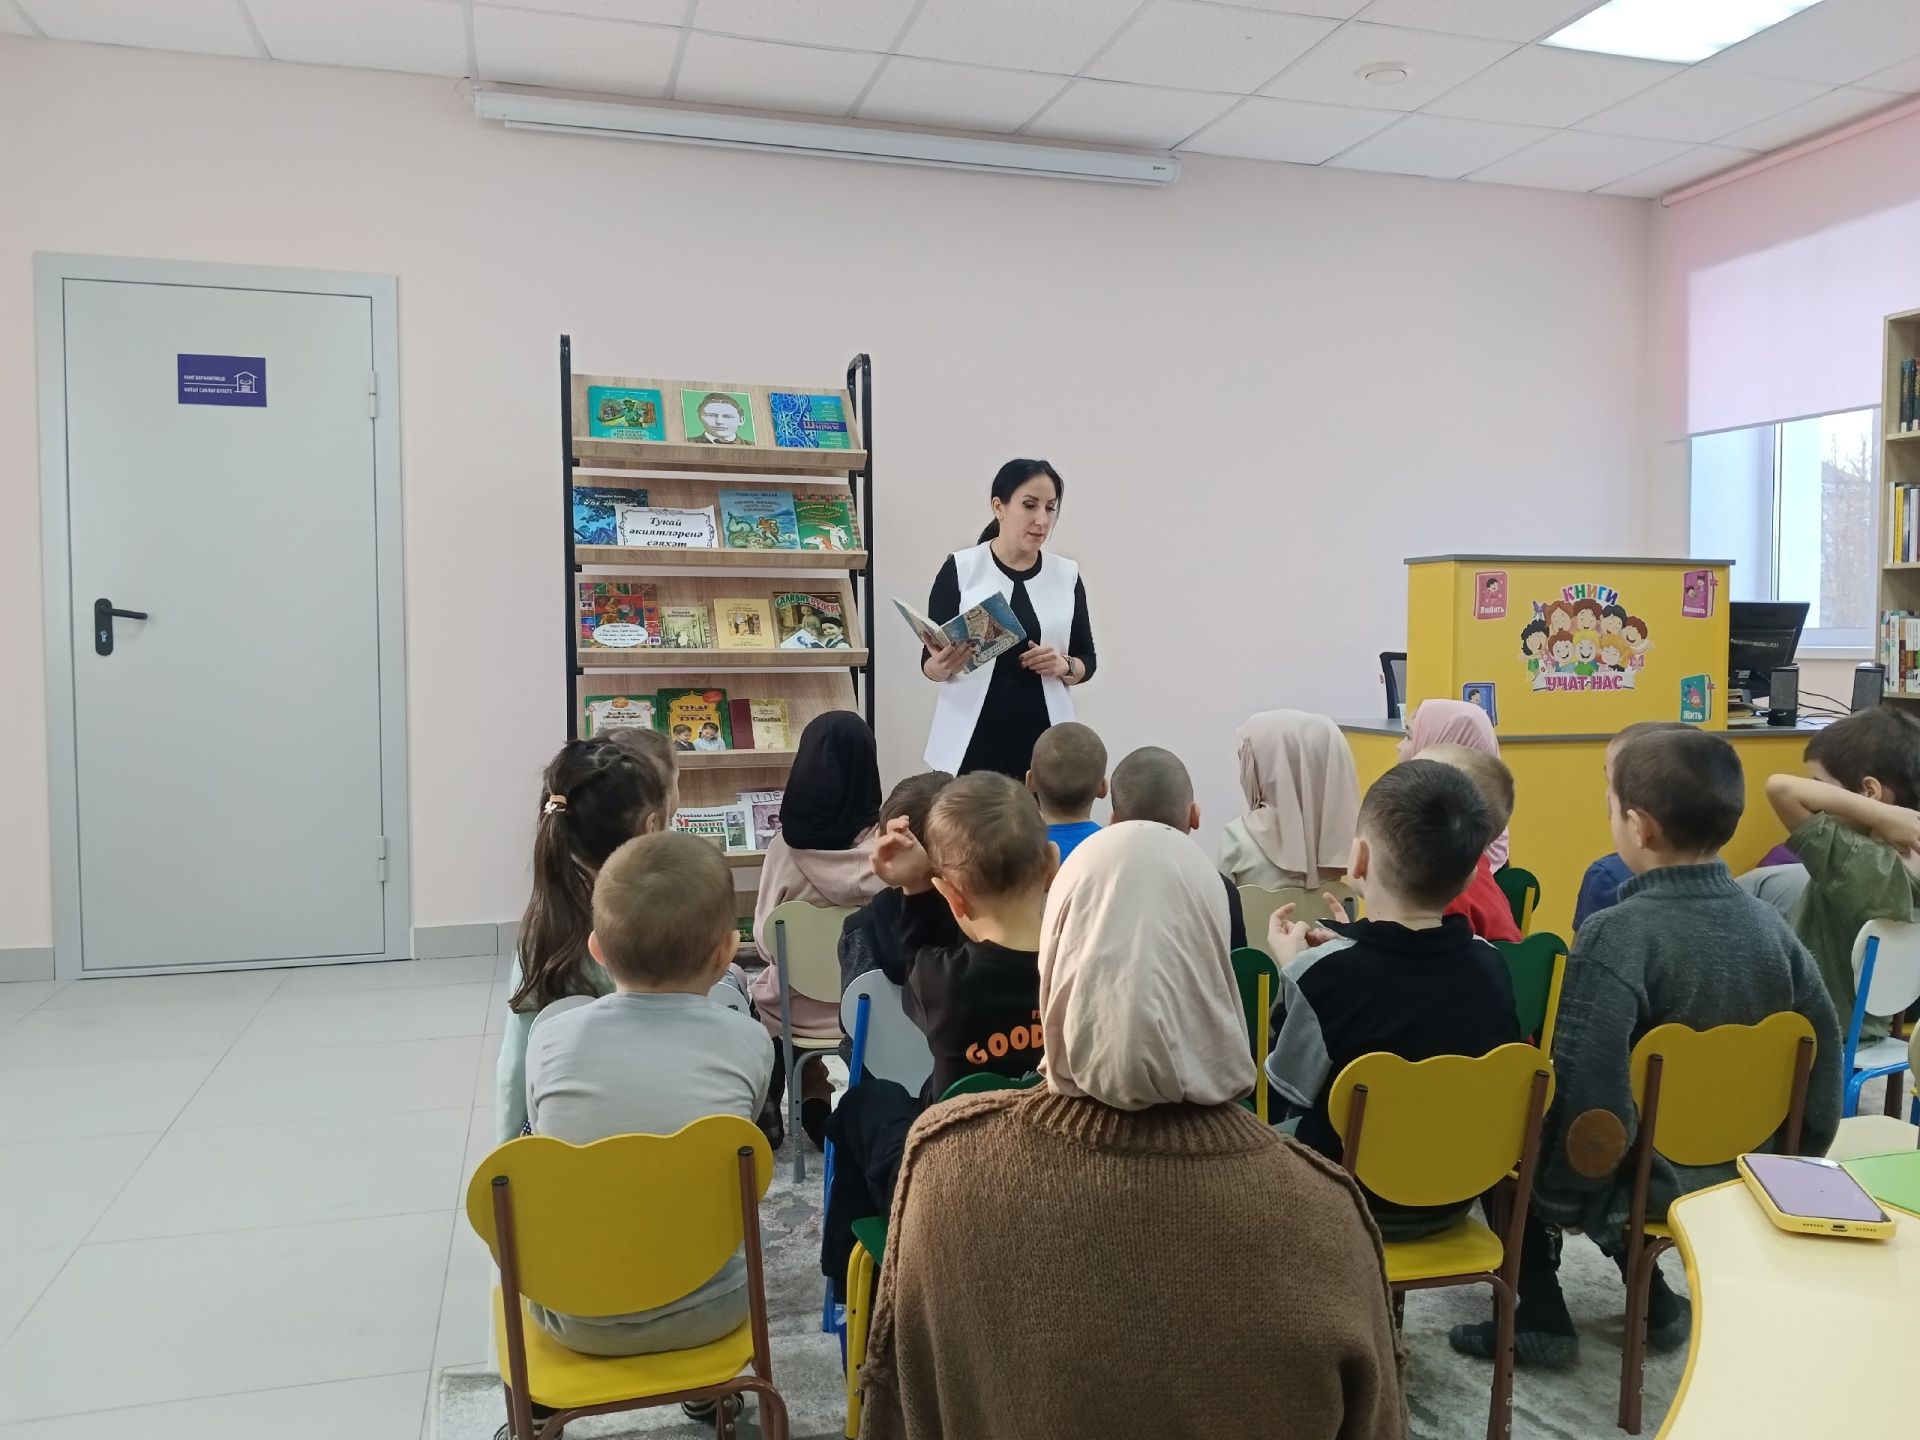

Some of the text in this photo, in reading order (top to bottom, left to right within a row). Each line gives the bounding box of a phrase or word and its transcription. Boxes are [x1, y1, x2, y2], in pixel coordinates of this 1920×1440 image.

[649, 516, 682, 527] Тукай
[629, 528, 703, 539] әкиятләренә
[646, 539, 688, 548] сәяхәт
[1562, 584, 1618, 605] КНИГИ
[1546, 675, 1623, 691] УЧАТ НАС
[1682, 710, 1703, 720] Жить
[966, 1024, 1045, 1065] GOOD
